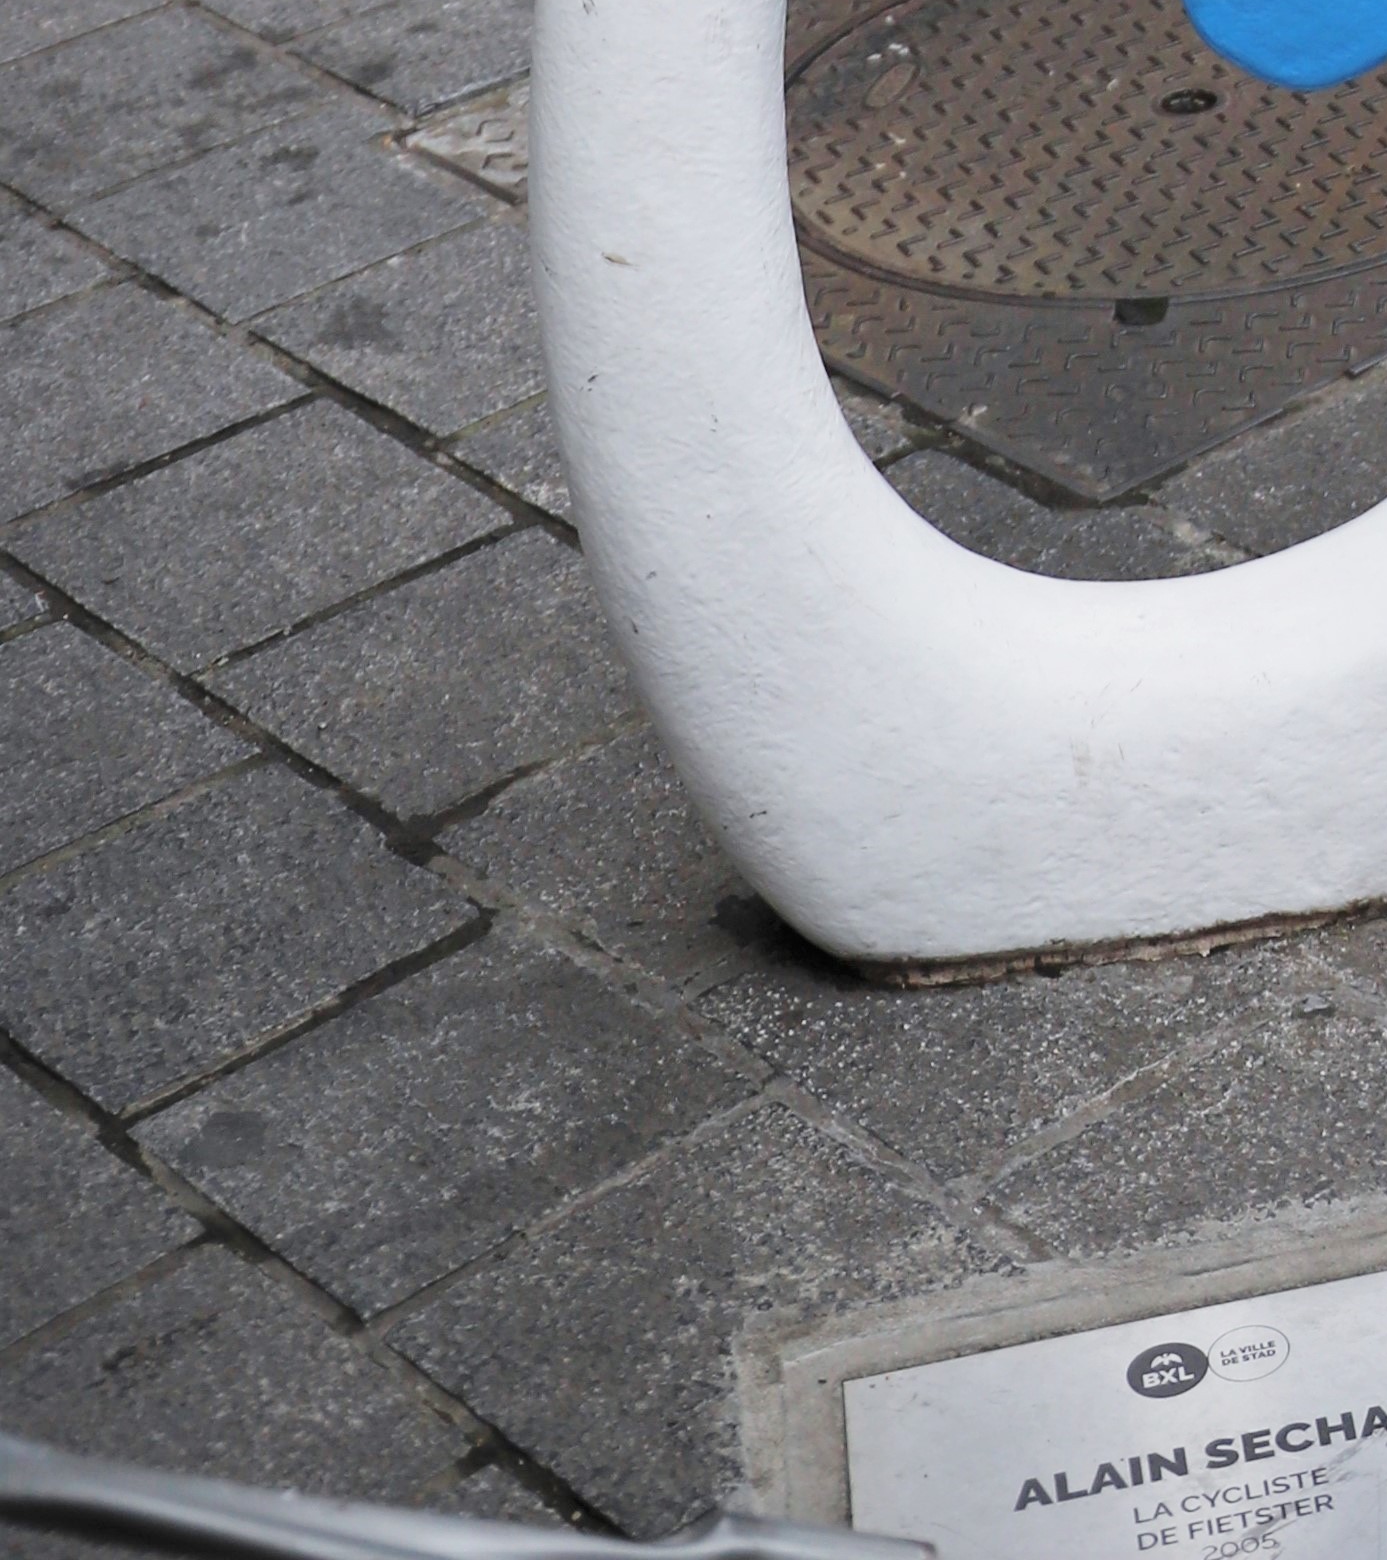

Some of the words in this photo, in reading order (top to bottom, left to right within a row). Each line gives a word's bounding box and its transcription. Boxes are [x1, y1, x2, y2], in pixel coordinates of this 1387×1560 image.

[1221, 1348, 1236, 1358] LA
[1239, 1340, 1276, 1353] VILLE
[1222, 1356, 1239, 1366] DE
[1243, 1349, 1276, 1362] STAD
[1142, 1366, 1195, 1389] BXL
[1013, 1446, 1189, 1512] ALAIN
[1133, 1504, 1173, 1524] LA
[1180, 1466, 1331, 1513] CYCLISTE
[1137, 1529, 1179, 1552] DE
[1189, 1493, 1335, 1540] FIETSTER
[1202, 1531, 1281, 1560] 2005
